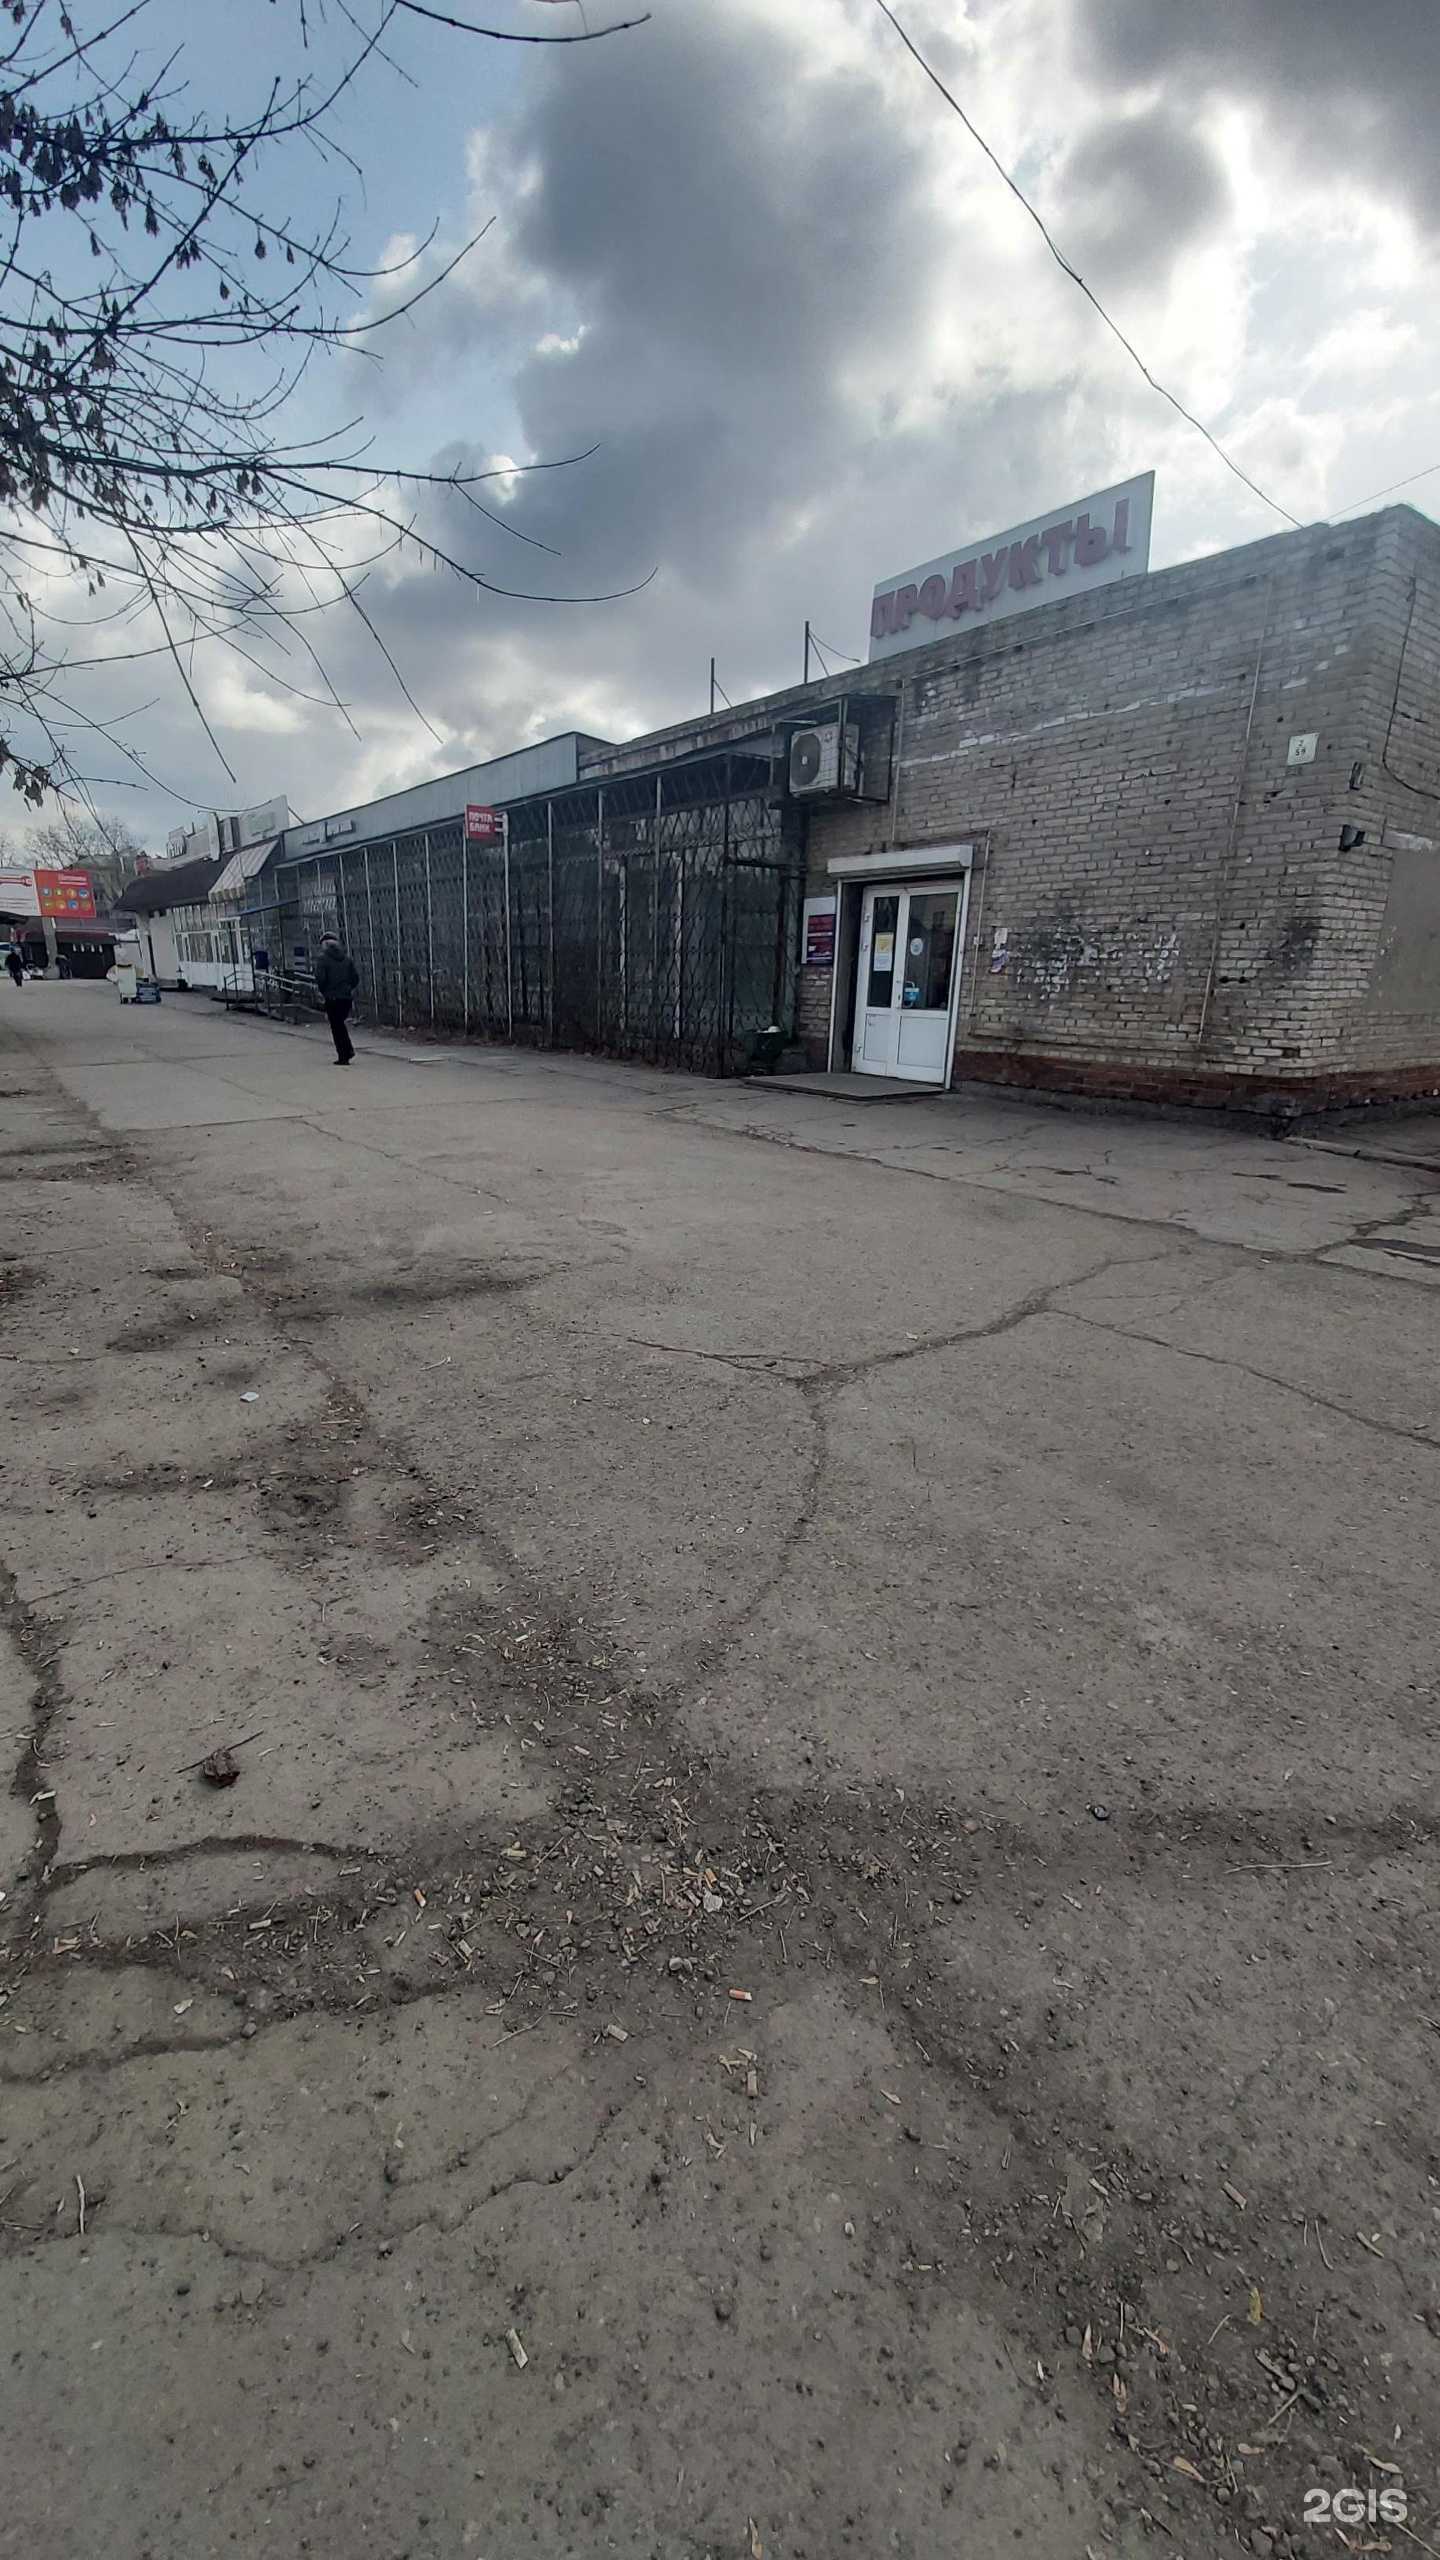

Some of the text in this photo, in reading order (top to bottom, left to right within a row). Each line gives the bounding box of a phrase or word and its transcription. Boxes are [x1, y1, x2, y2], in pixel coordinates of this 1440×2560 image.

[870, 499, 1130, 638] ПРОДУКТЫ
[469, 811, 493, 823] ПОЧТА
[470, 822, 490, 832] БАНК
